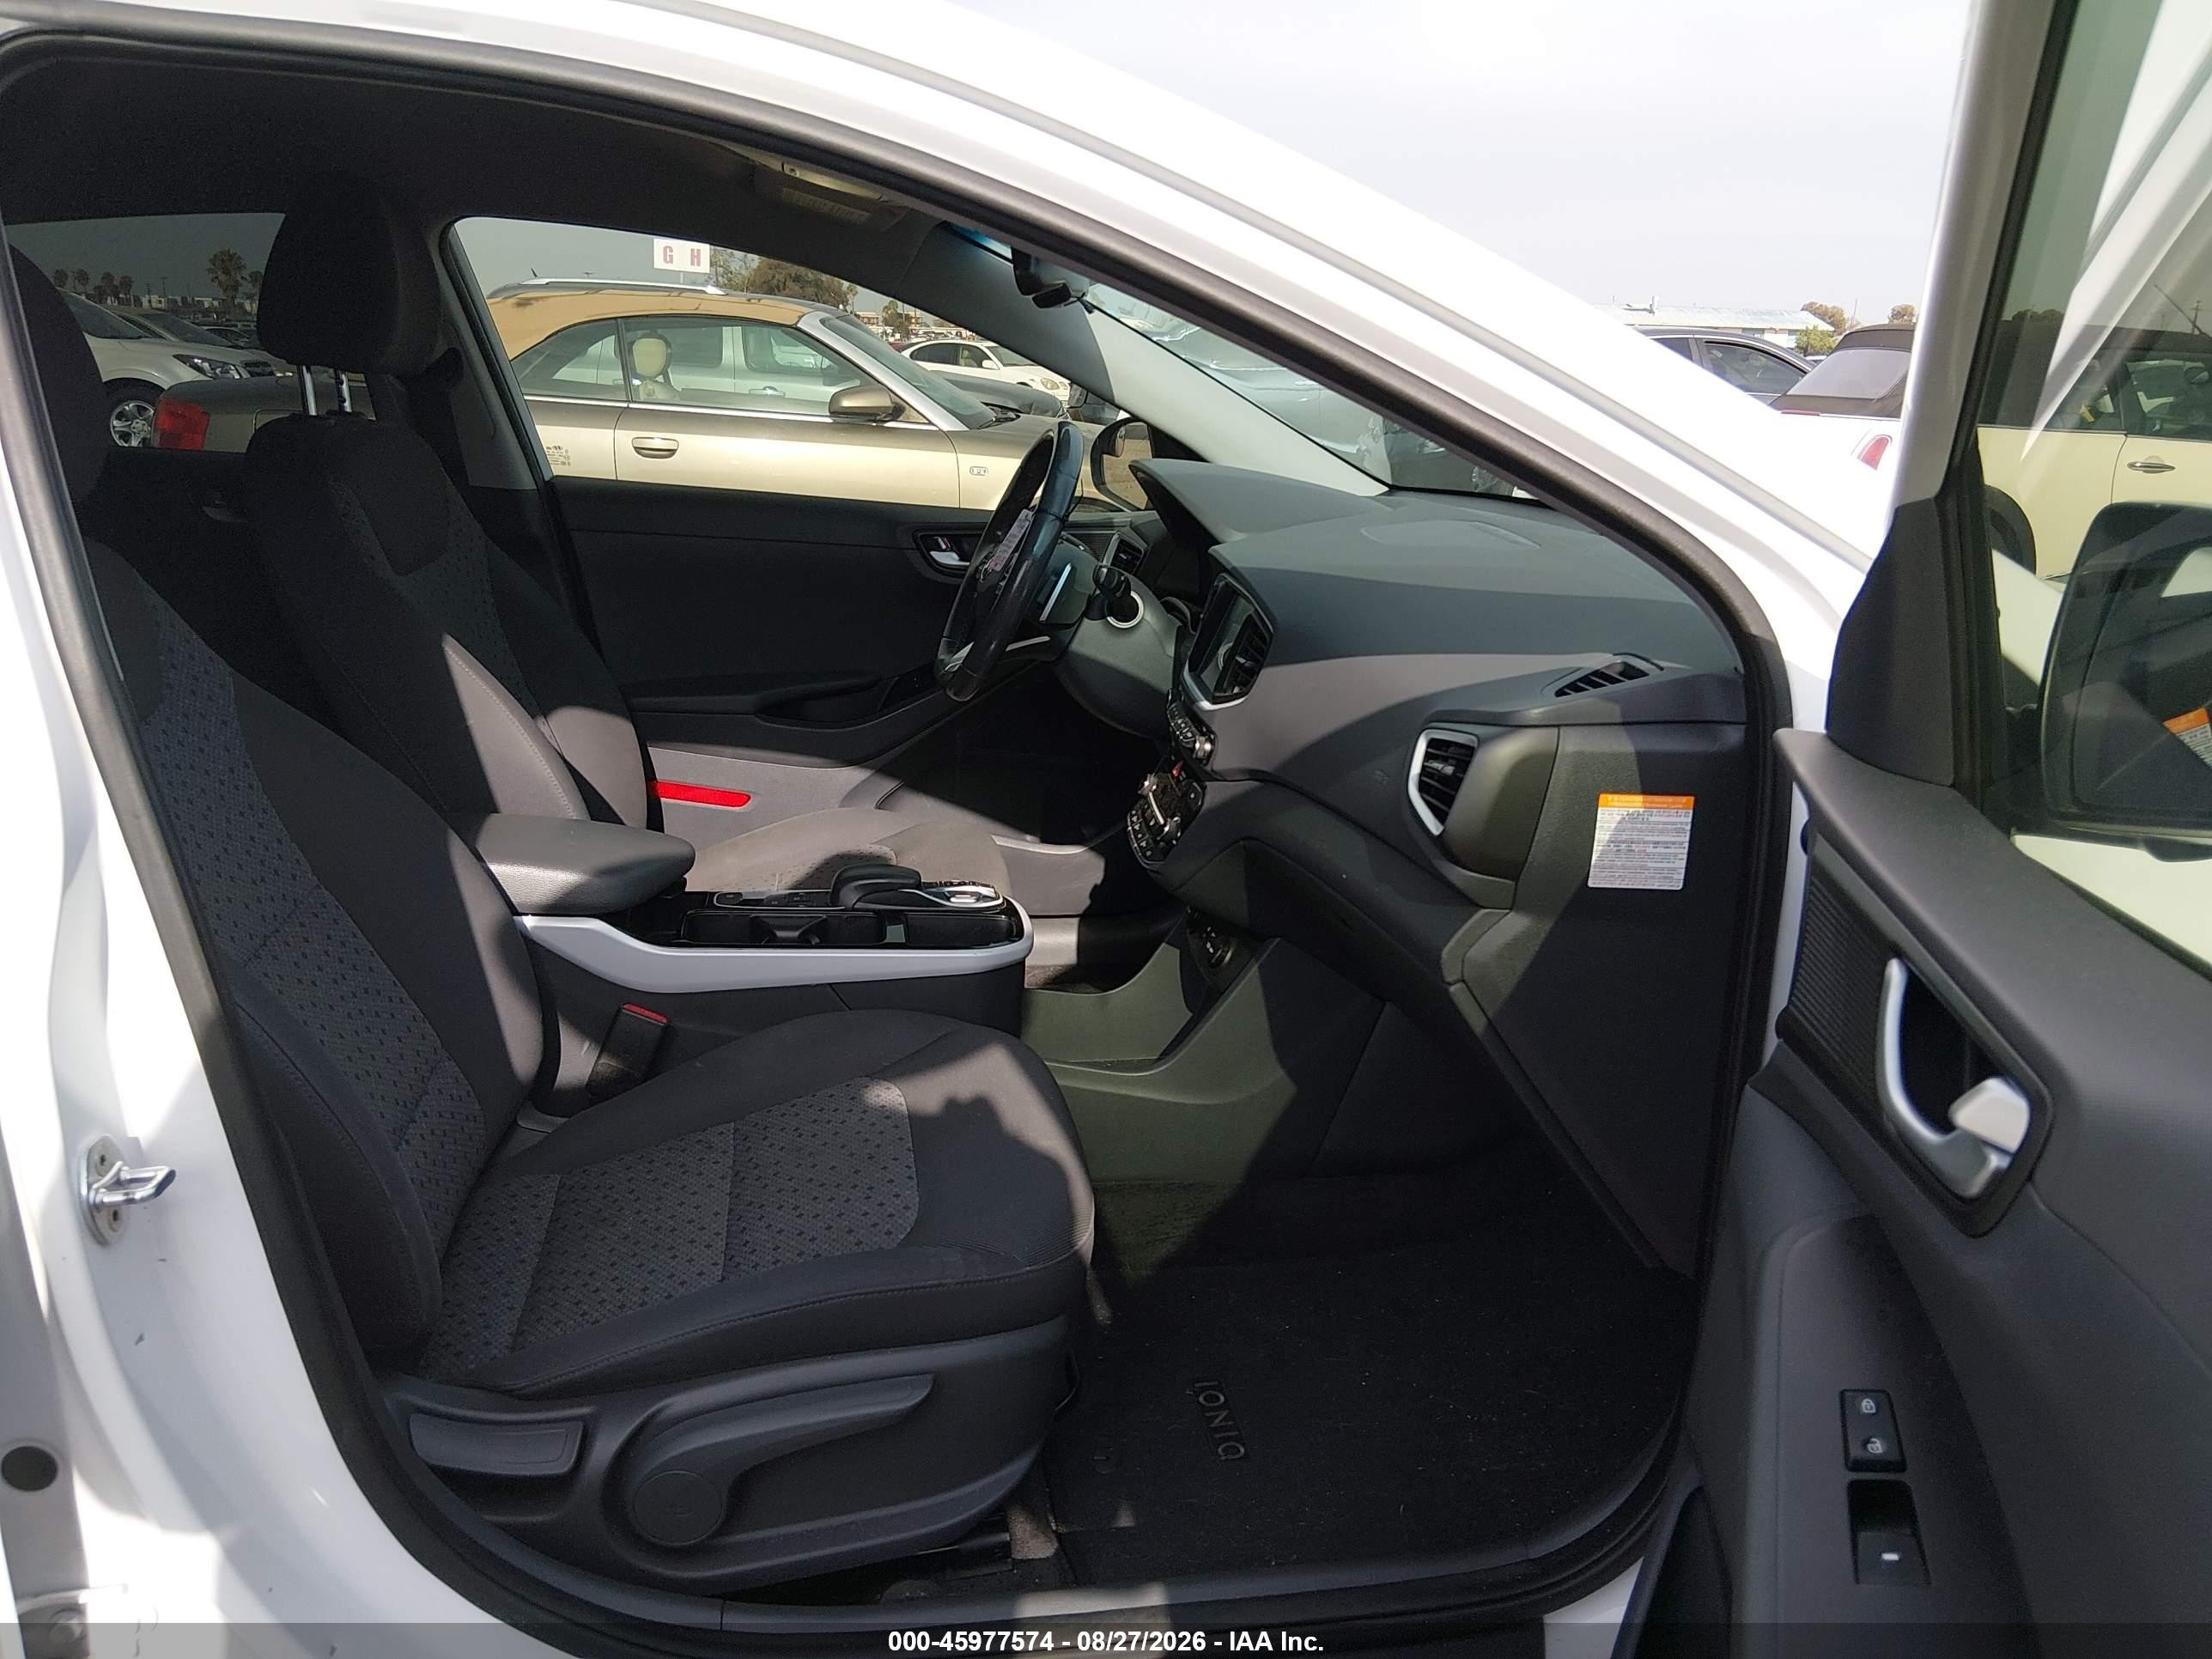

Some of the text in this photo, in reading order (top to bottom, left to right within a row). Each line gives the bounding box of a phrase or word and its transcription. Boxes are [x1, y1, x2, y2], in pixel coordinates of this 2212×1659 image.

[662, 246, 702, 267] G H
[1194, 1380, 1246, 1461] IONIQ
